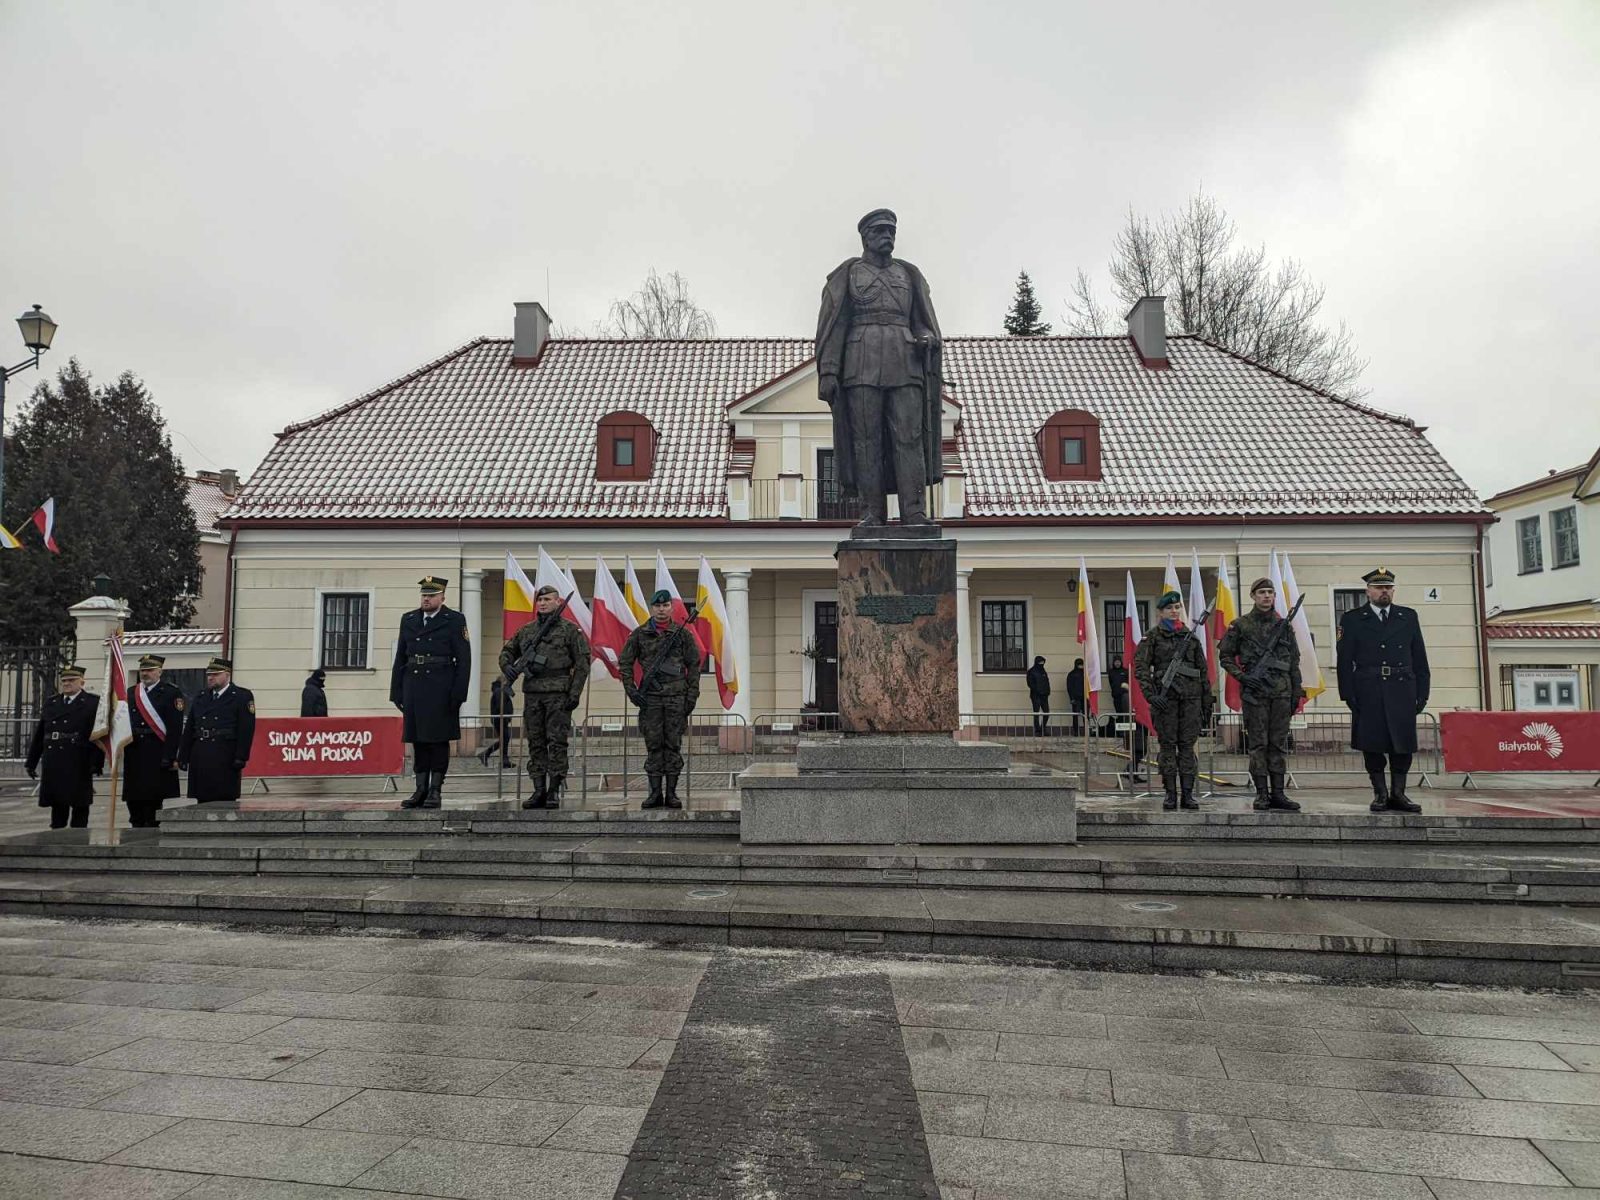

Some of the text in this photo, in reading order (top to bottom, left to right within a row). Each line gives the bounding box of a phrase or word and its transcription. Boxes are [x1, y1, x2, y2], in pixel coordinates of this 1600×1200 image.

[1429, 587, 1438, 600] 4
[305, 731, 373, 747] SAMORZĄD
[1498, 740, 1542, 753] Białystok
[321, 747, 364, 762] POLSKA
